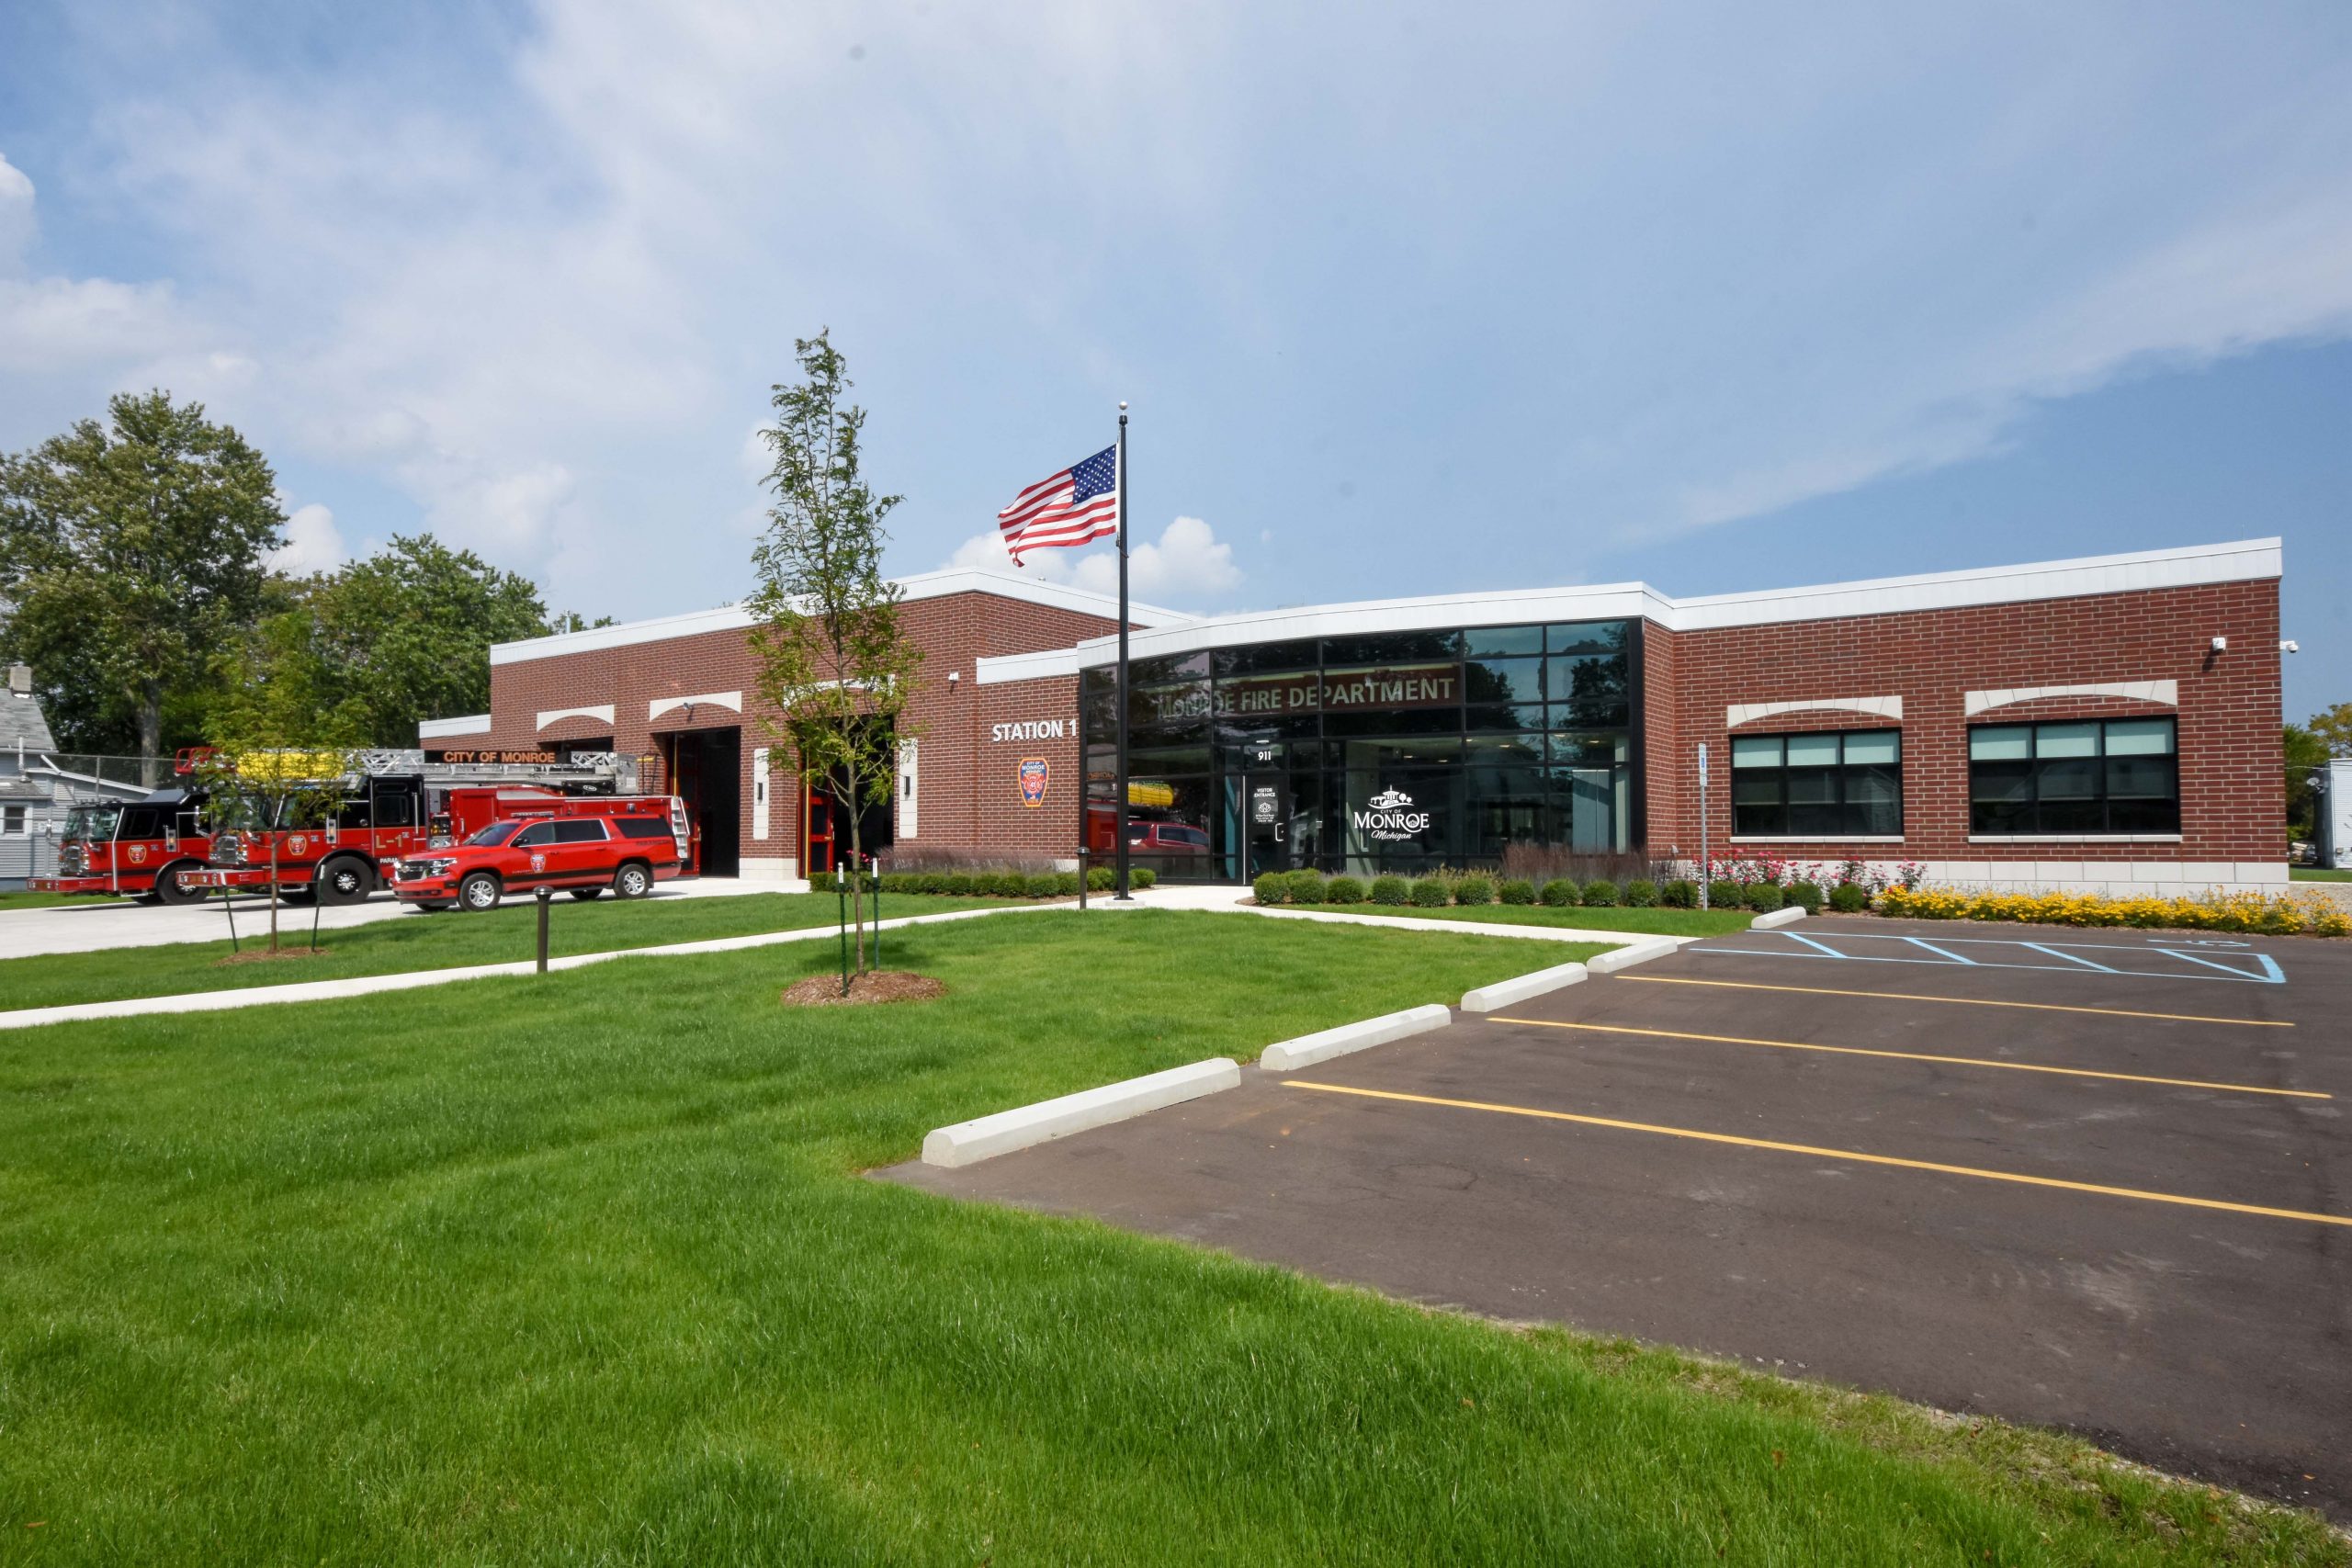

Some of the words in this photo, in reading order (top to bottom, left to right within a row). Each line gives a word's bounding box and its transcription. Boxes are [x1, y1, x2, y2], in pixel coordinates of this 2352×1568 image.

[1241, 689, 1282, 711] FIRE
[992, 720, 1063, 742] STATION
[1069, 718, 1077, 737] 1
[444, 751, 474, 763] CITY
[479, 751, 497, 762] OF
[501, 751, 555, 763] MONROE
[1258, 750, 1272, 761] 911
[1353, 811, 1430, 833] MONROE
[376, 834, 401, 849] L-1
[1371, 829, 1412, 841] Michigan
